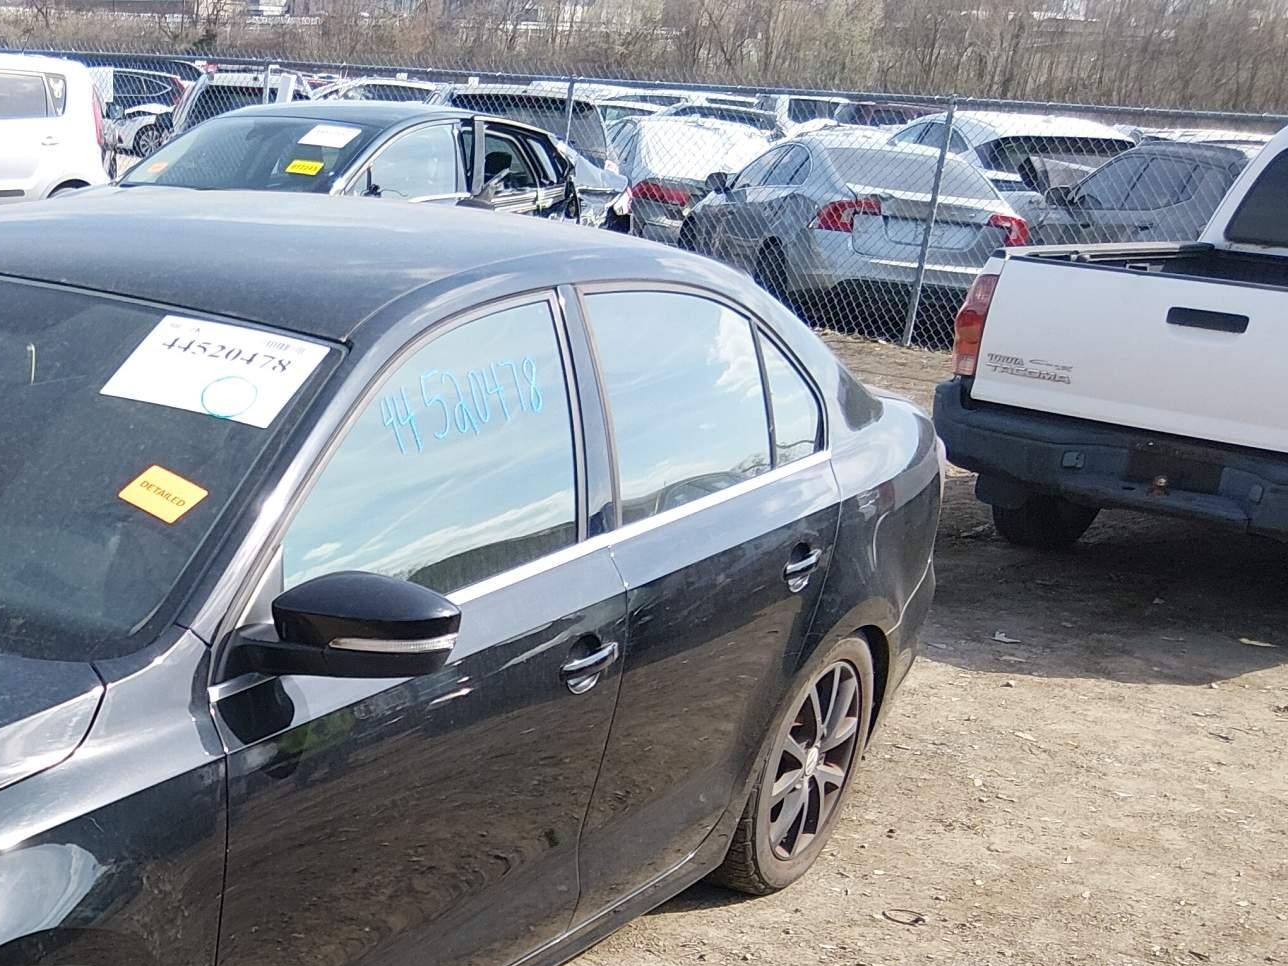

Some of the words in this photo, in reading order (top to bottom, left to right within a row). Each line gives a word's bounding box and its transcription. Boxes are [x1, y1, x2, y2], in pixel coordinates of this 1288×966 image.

[162, 337, 291, 373] 44520478
[987, 353, 1025, 366] TOYOTA
[985, 362, 1071, 385] TACOMA
[140, 480, 186, 507] DETAILED
